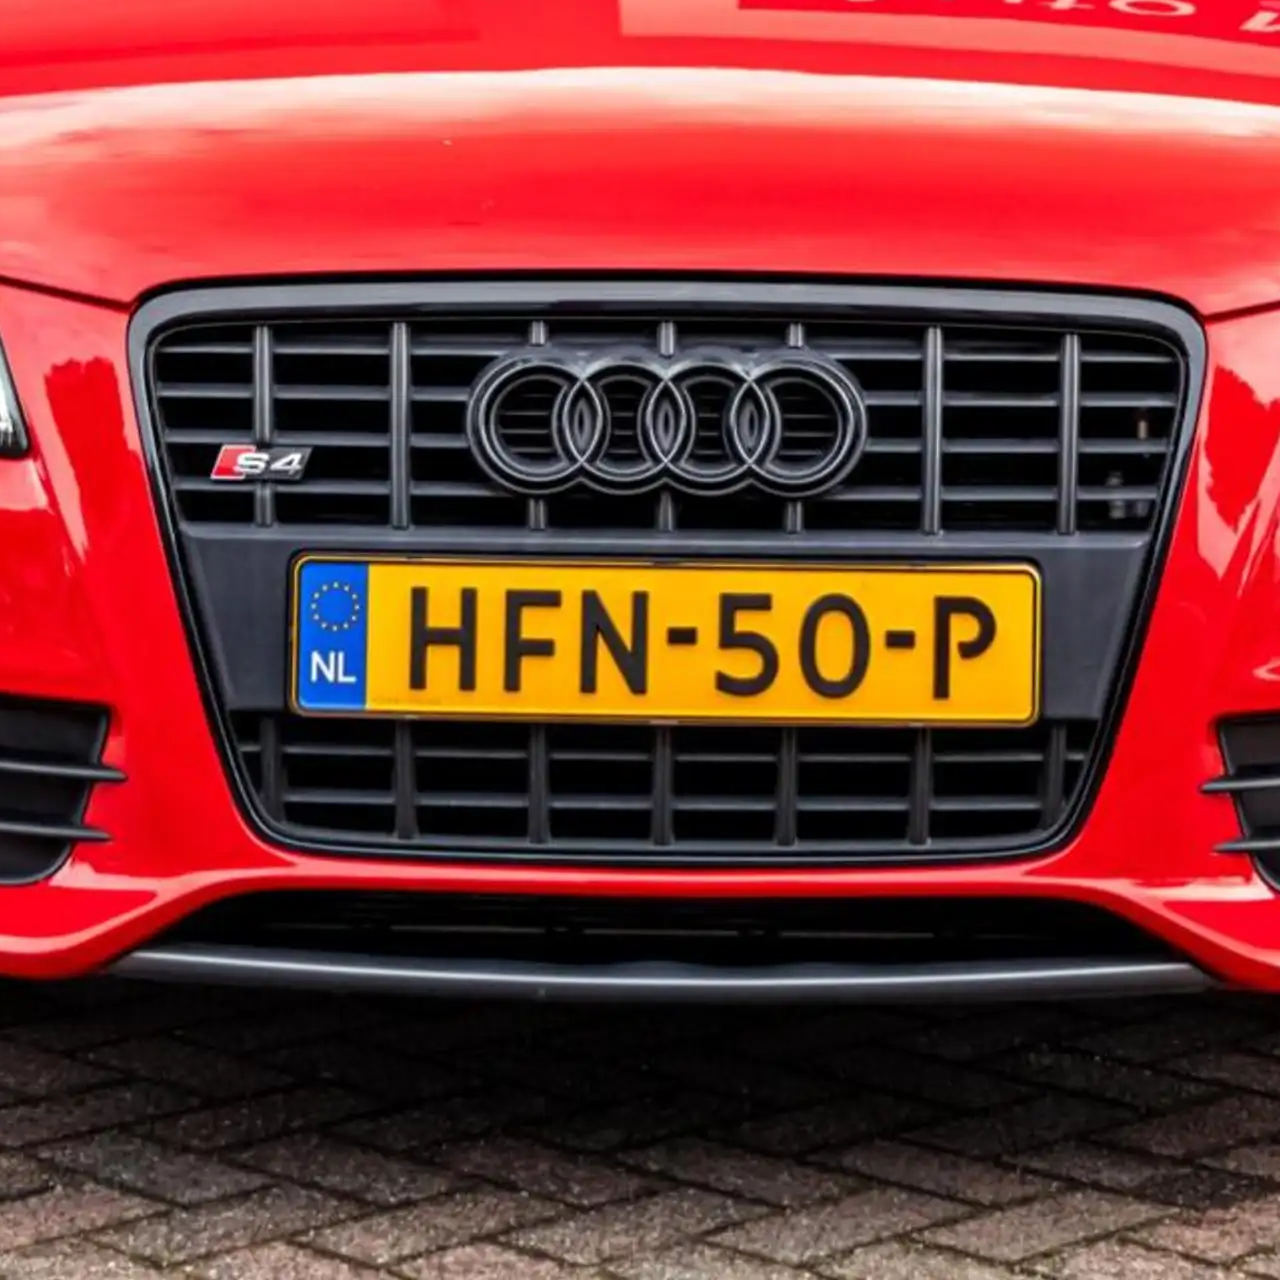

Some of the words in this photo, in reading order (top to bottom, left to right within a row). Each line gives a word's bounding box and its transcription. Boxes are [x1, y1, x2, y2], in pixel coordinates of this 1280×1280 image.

[231, 450, 304, 476] S4
[409, 587, 996, 700] HFN-50-P
[310, 651, 357, 683] NL
